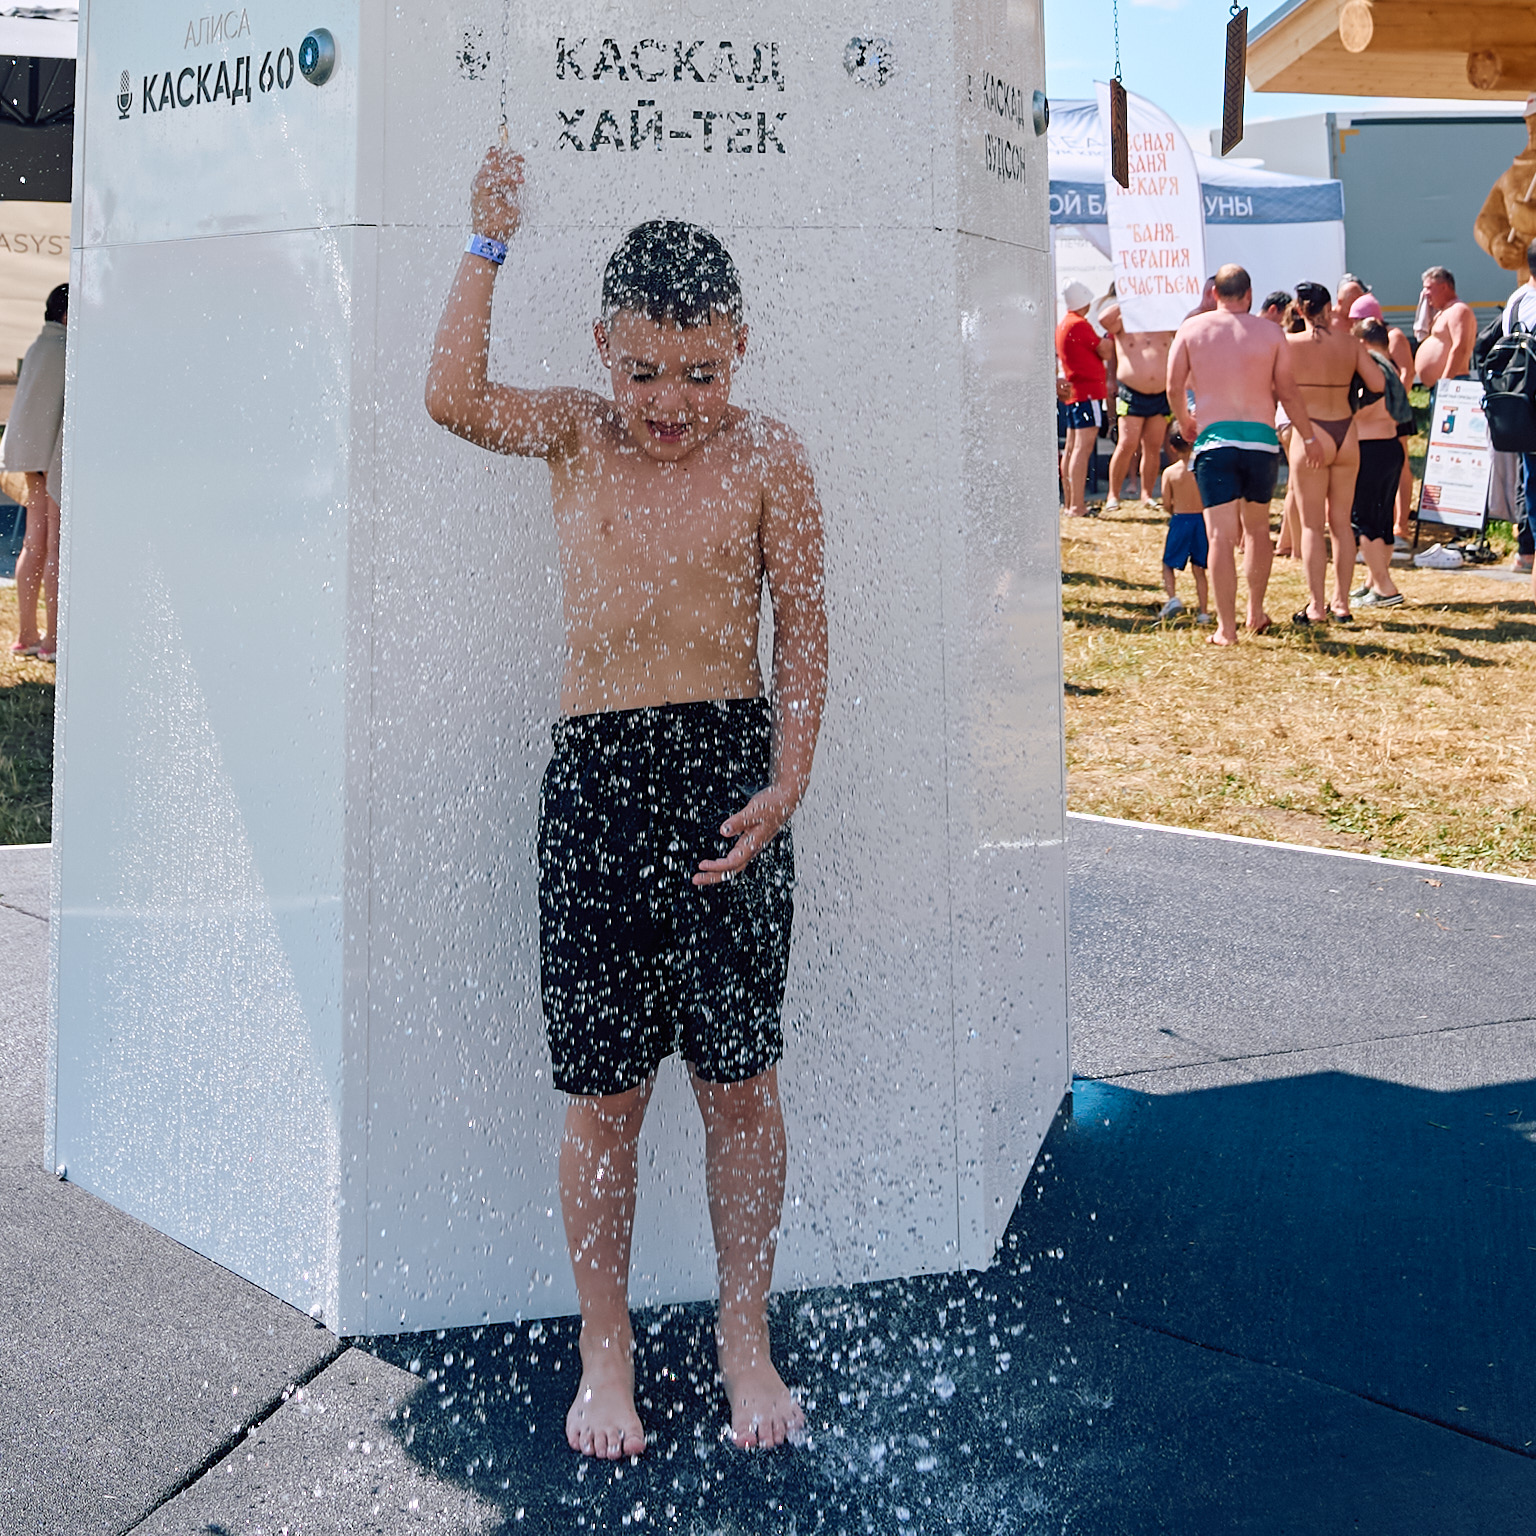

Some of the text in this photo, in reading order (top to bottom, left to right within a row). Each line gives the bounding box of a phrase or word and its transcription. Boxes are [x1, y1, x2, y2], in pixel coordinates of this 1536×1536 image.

[183, 7, 251, 50] АЛИСА
[142, 46, 295, 106] КАСКАД 60
[554, 37, 786, 92] КАСКАД
[982, 69, 1026, 133] КАСКАД
[553, 99, 788, 154] ХАЙ-ТЕК
[1048, 190, 1082, 216] ОЙ
[1204, 195, 1253, 217] УНЫ
[1118, 247, 1190, 269] ТЕРАПИЯ
[1117, 274, 1200, 296] СЧАСТЬЕМ
